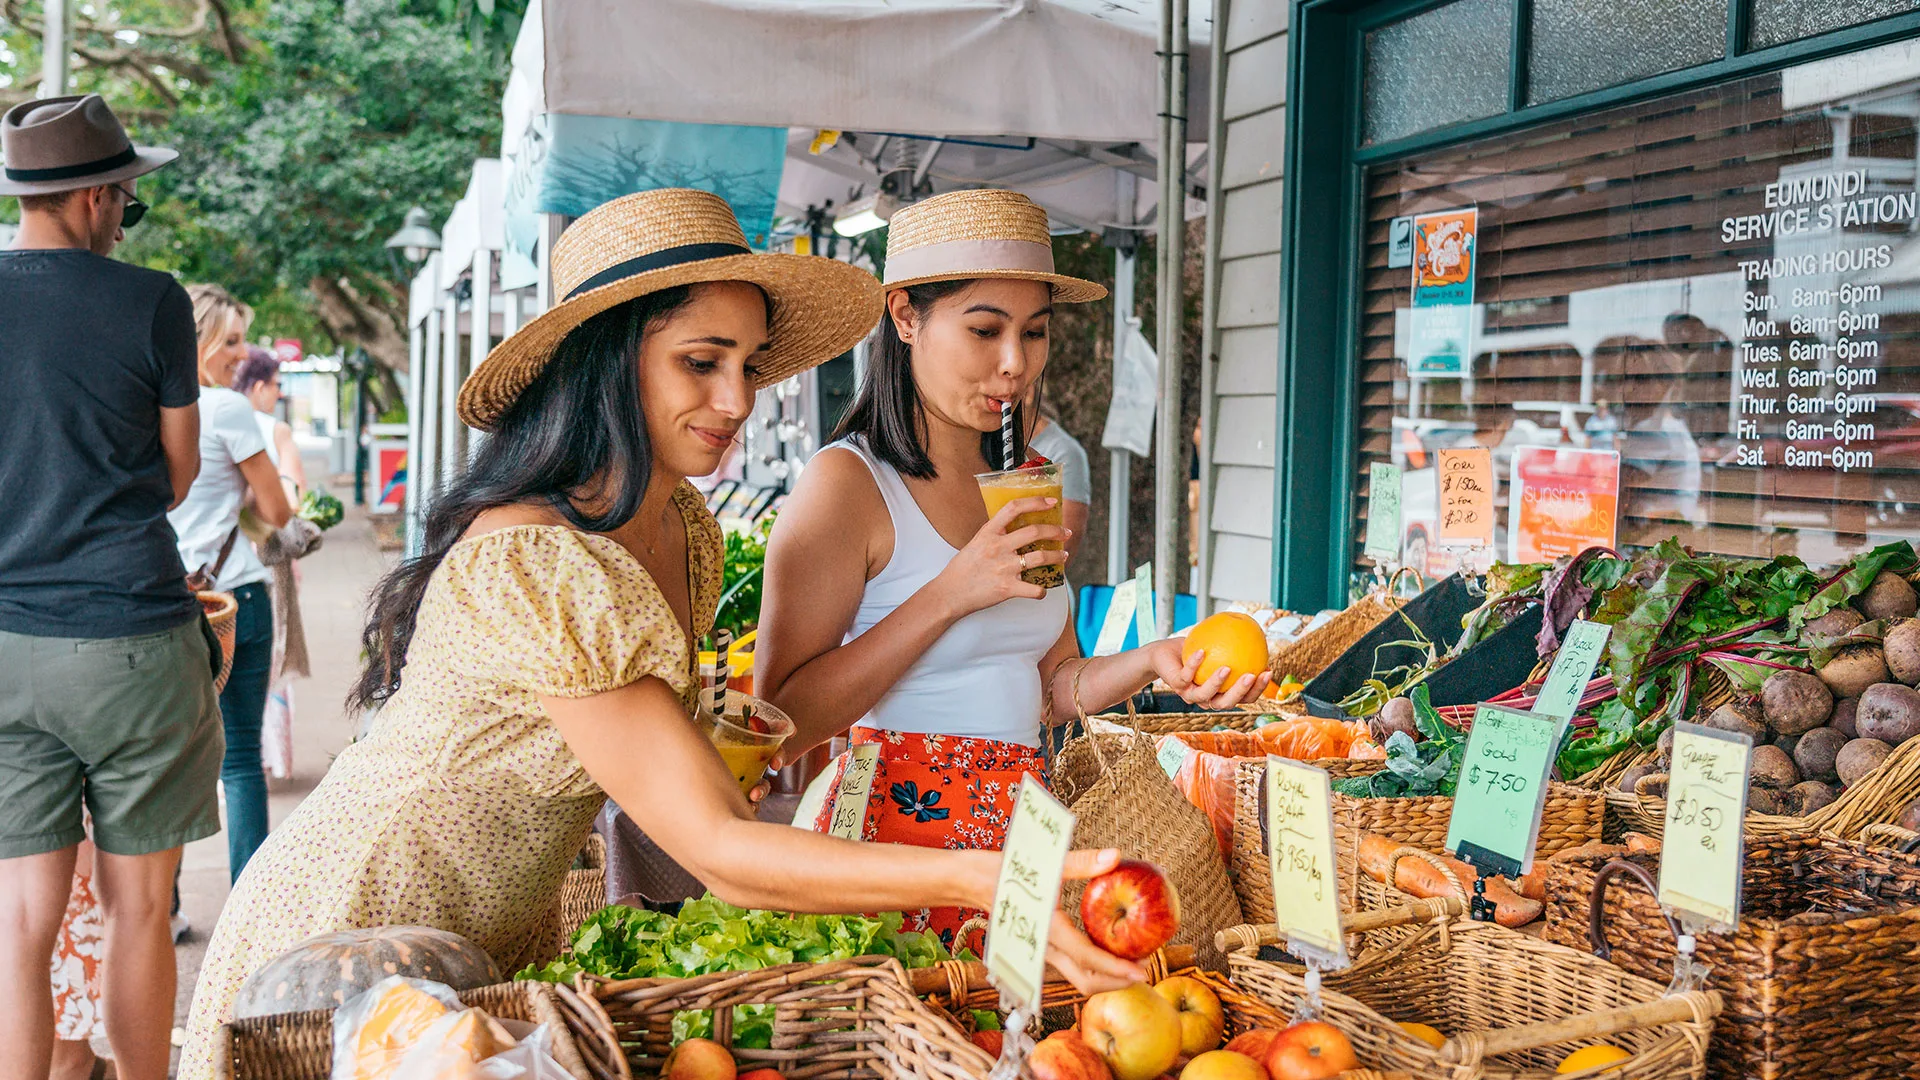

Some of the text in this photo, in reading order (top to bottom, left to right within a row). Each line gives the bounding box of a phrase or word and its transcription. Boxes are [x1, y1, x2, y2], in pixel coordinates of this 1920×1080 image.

[1765, 168, 1867, 209] EUMUNDI
[1720, 191, 1916, 244] SERVICE STATION
[1737, 244, 1892, 281] TRADING HOURS
[1743, 282, 1882, 313] Sun. 8am-6pm
[1741, 310, 1880, 338] Mon. 6am-6pm
[1741, 337, 1878, 364] Tues. 6am-6pm
[1740, 364, 1877, 391] Wed. 6am-6pm
[1739, 391, 1876, 418] Thur. 6am-6pm
[1736, 418, 1875, 445] Fri. 6am-6pm
[1736, 444, 1873, 473] Sat. 6am-6pm
[1523, 483, 1585, 505] sunshine
